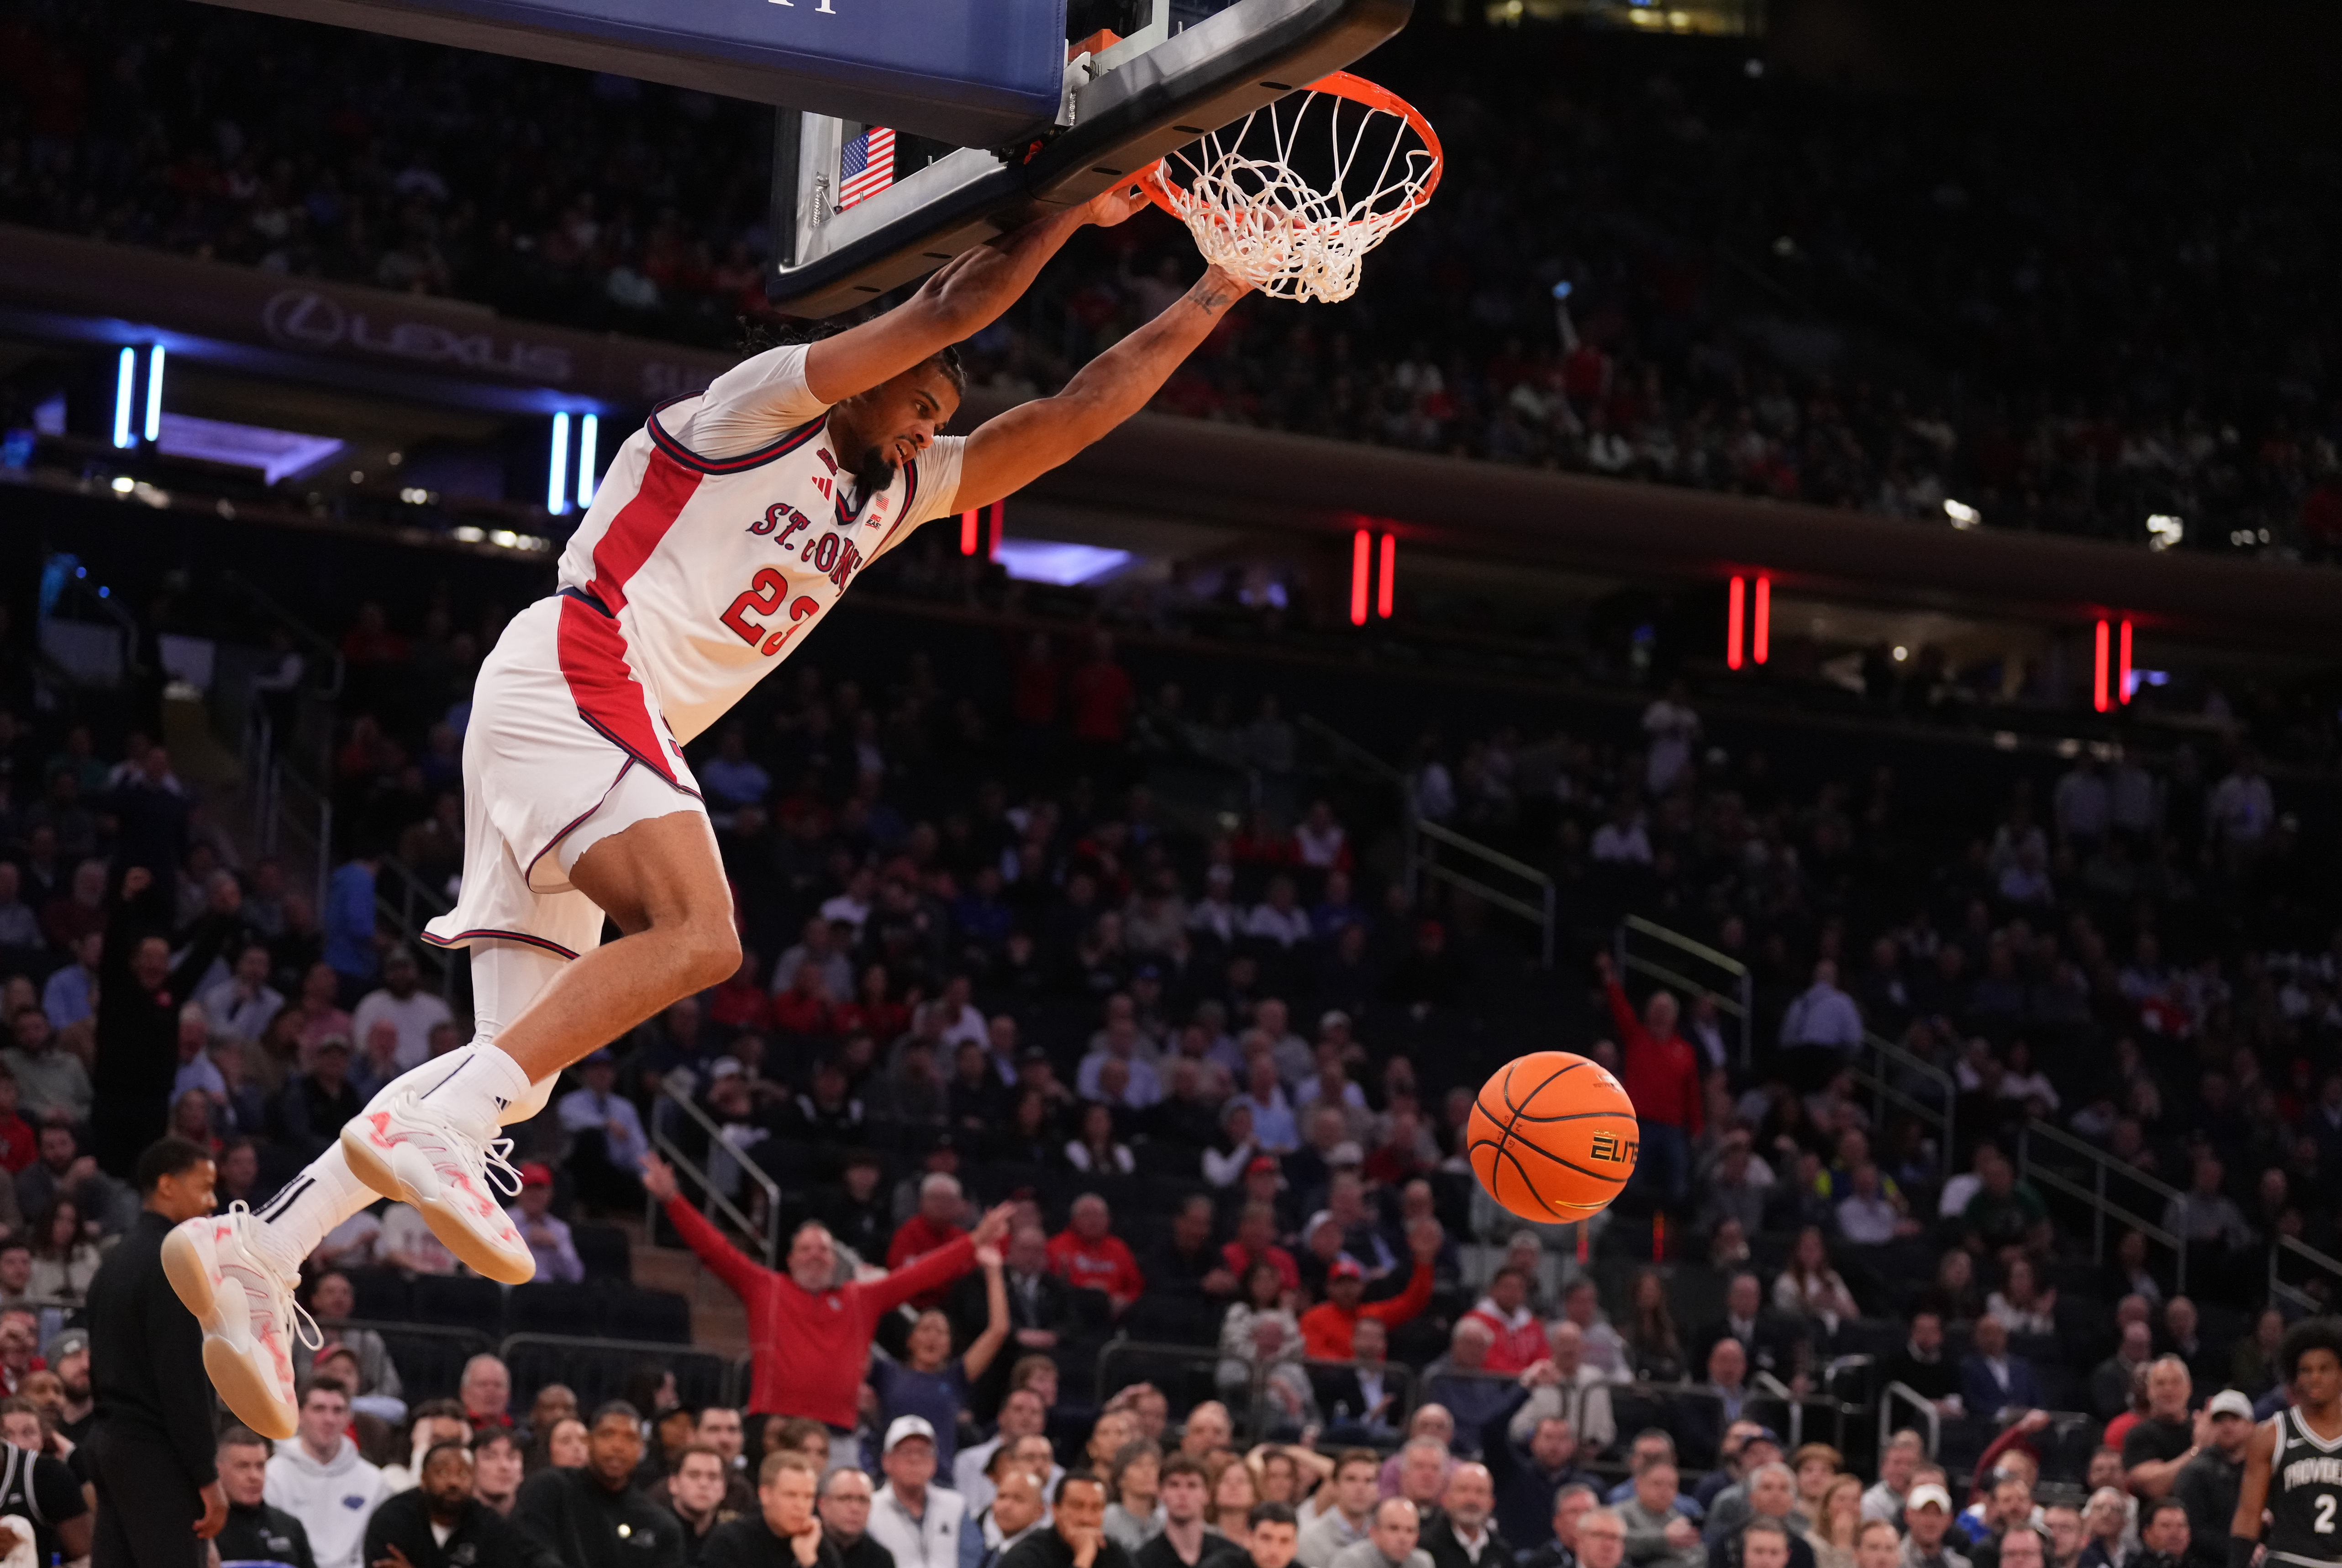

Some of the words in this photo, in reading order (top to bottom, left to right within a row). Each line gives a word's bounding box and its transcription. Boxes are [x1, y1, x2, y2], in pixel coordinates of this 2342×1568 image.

[745, 503, 811, 551] ST.
[866, 519, 881, 529] EAST
[870, 514, 882, 522] BIG
[719, 568, 820, 656] 23
[2314, 1494, 2337, 1534] 2
